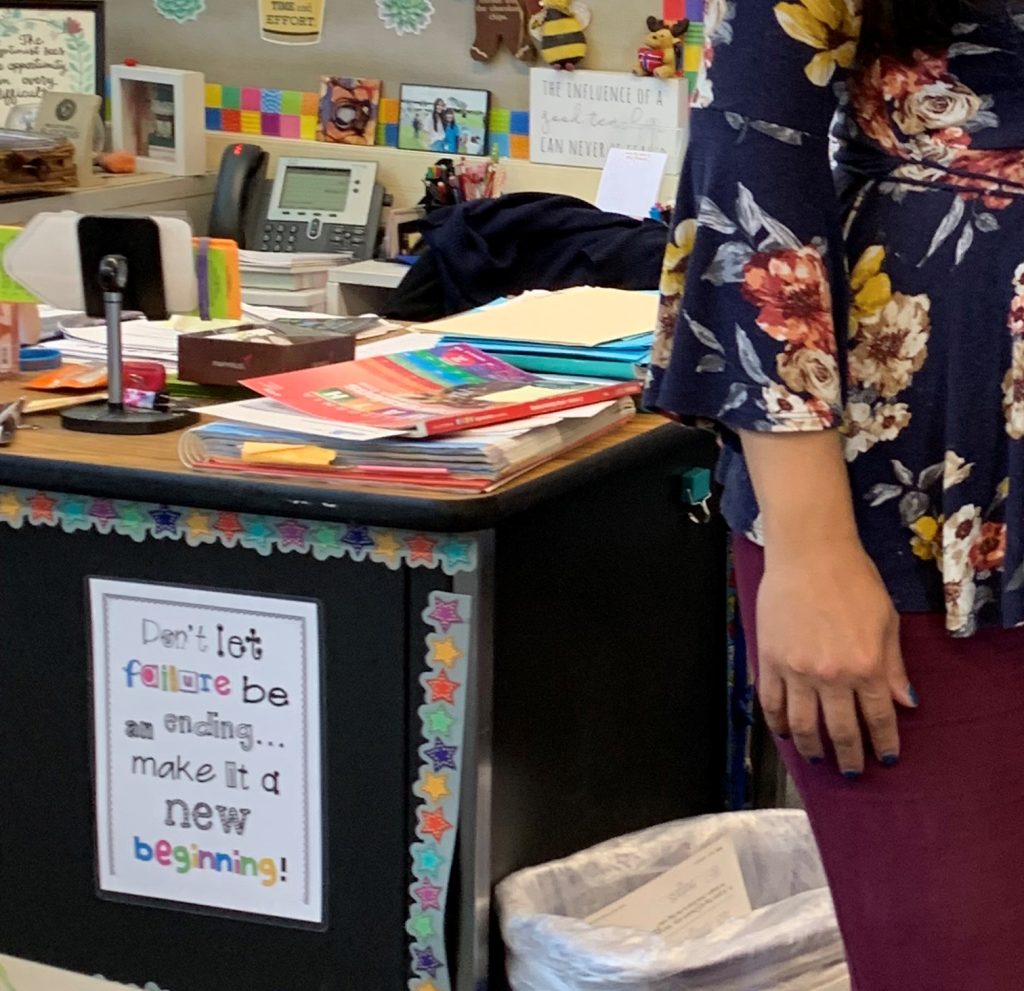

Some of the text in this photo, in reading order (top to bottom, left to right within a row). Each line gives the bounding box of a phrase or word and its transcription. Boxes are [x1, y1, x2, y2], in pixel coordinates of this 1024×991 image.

[265, 14, 315, 27] EFFORT
[542, 79, 664, 106] THE INFLUENCE OF A
[540, 137, 563, 155] CAN
[569, 140, 606, 158] NEVER
[142, 618, 263, 660] Don't let
[122, 659, 289, 707] failure be
[125, 719, 154, 740] an
[131, 754, 280, 795] make it a
[164, 798, 251, 836] new
[134, 836, 288, 887] beginning!
